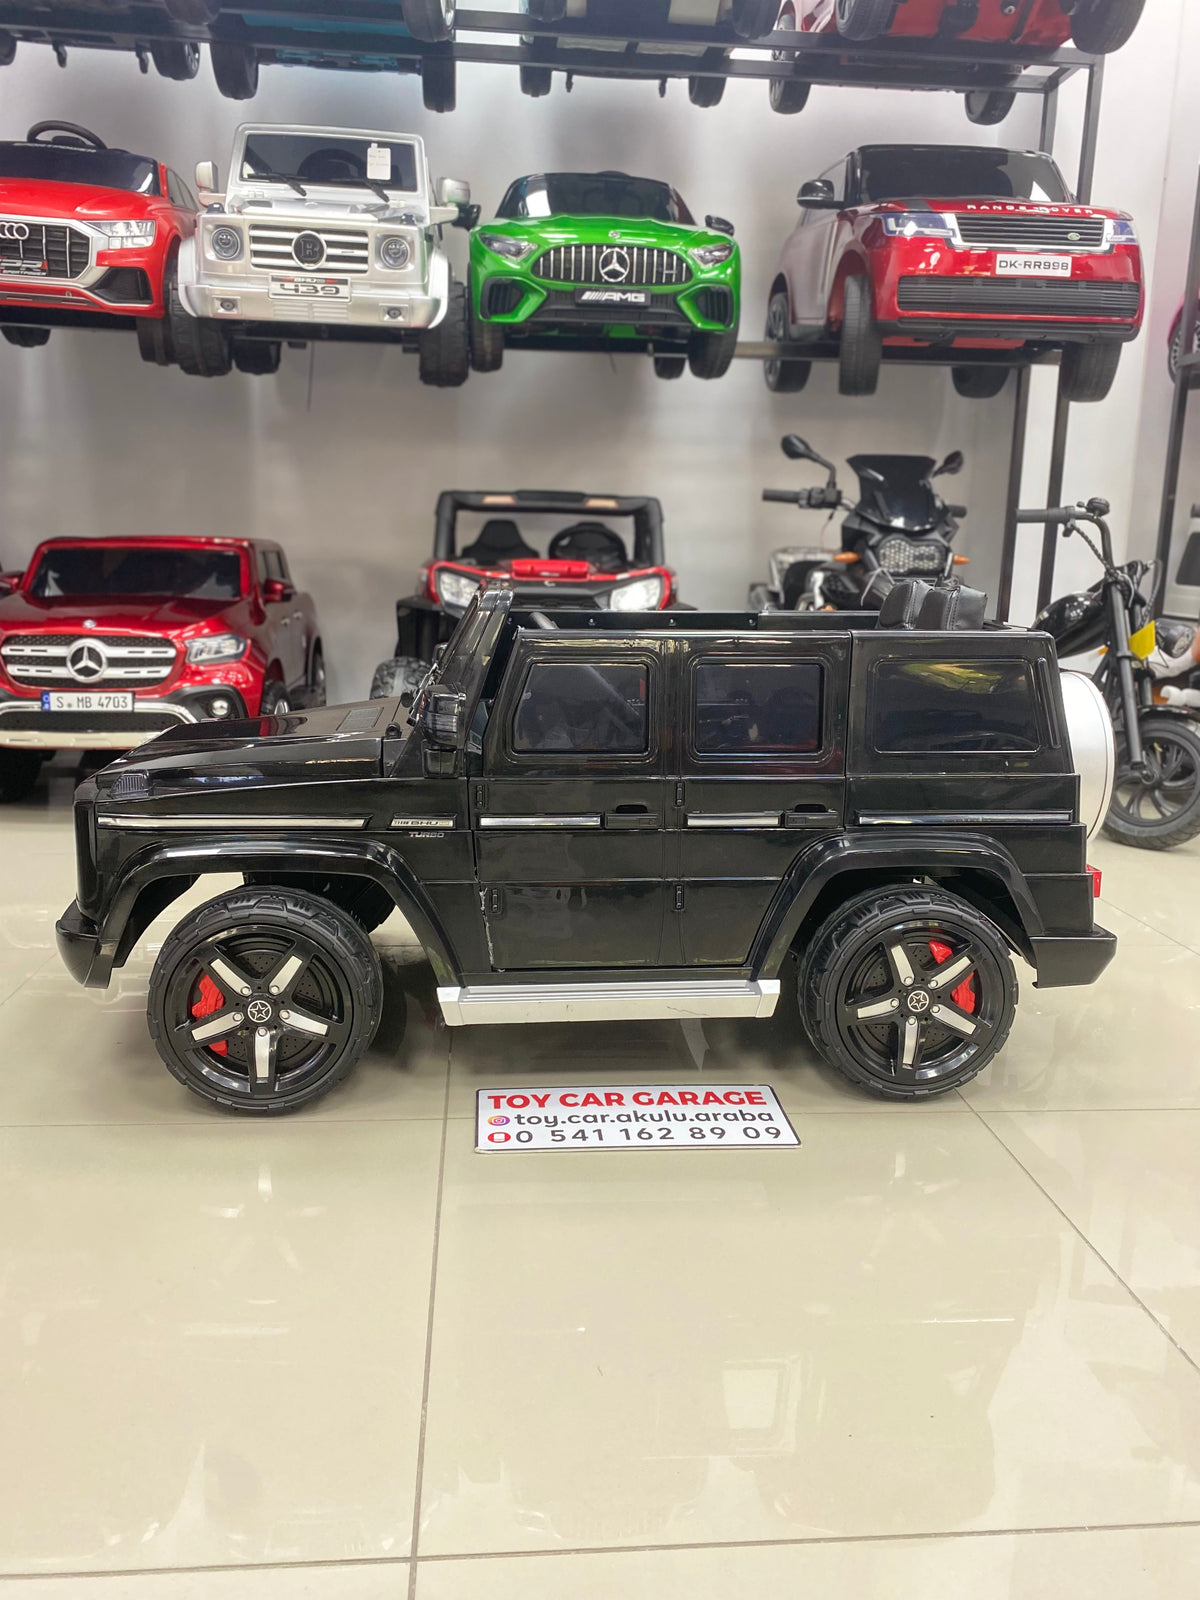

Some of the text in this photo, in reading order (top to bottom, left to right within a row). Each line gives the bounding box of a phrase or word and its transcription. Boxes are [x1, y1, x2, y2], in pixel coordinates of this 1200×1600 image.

[998, 259, 1069, 271] DK-RR998
[77, 696, 92, 709] MB
[97, 696, 128, 709] 4703
[487, 1091, 768, 1110] TOY CAR GARAGE
[514, 1109, 775, 1128] toy.car.akulu.araba
[515, 1126, 782, 1144] 0 541 162 89 09
